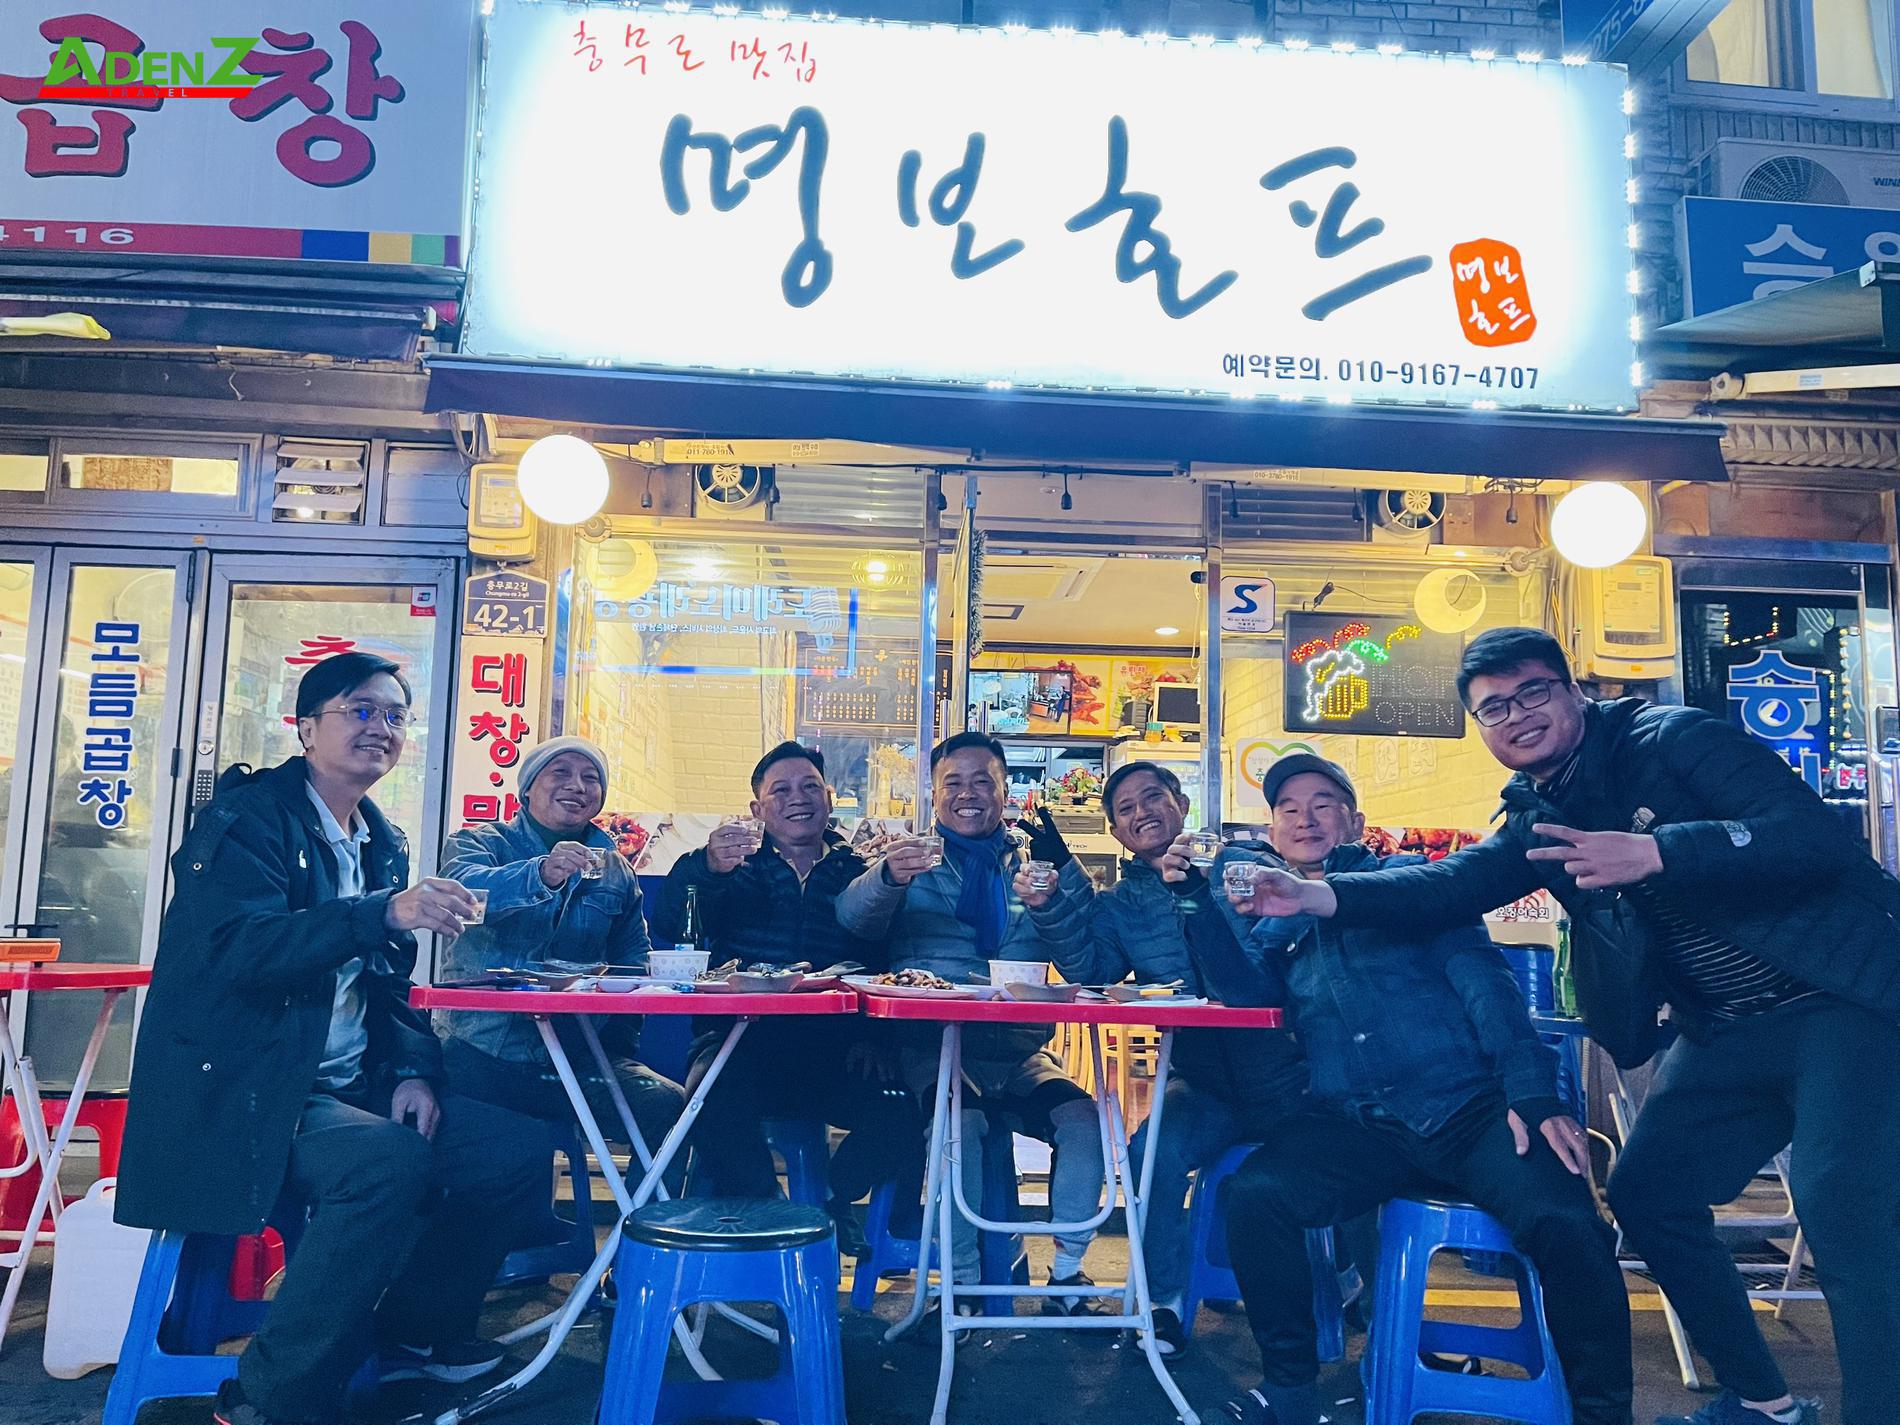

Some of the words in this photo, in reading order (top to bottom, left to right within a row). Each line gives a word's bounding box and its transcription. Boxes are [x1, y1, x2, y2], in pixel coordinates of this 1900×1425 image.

[573, 20, 706, 76] 충무로
[730, 37, 817, 83] 맛집
[1873, 176, 1900, 187] WIN
[1338, 359, 1539, 390] 010-9167-4707
[474, 604, 534, 629] 42-1
[79, 622, 141, 829] 모듬곱창
[1375, 701, 1456, 726] OPEN
[1496, 906, 1549, 919] 오징어숙회
